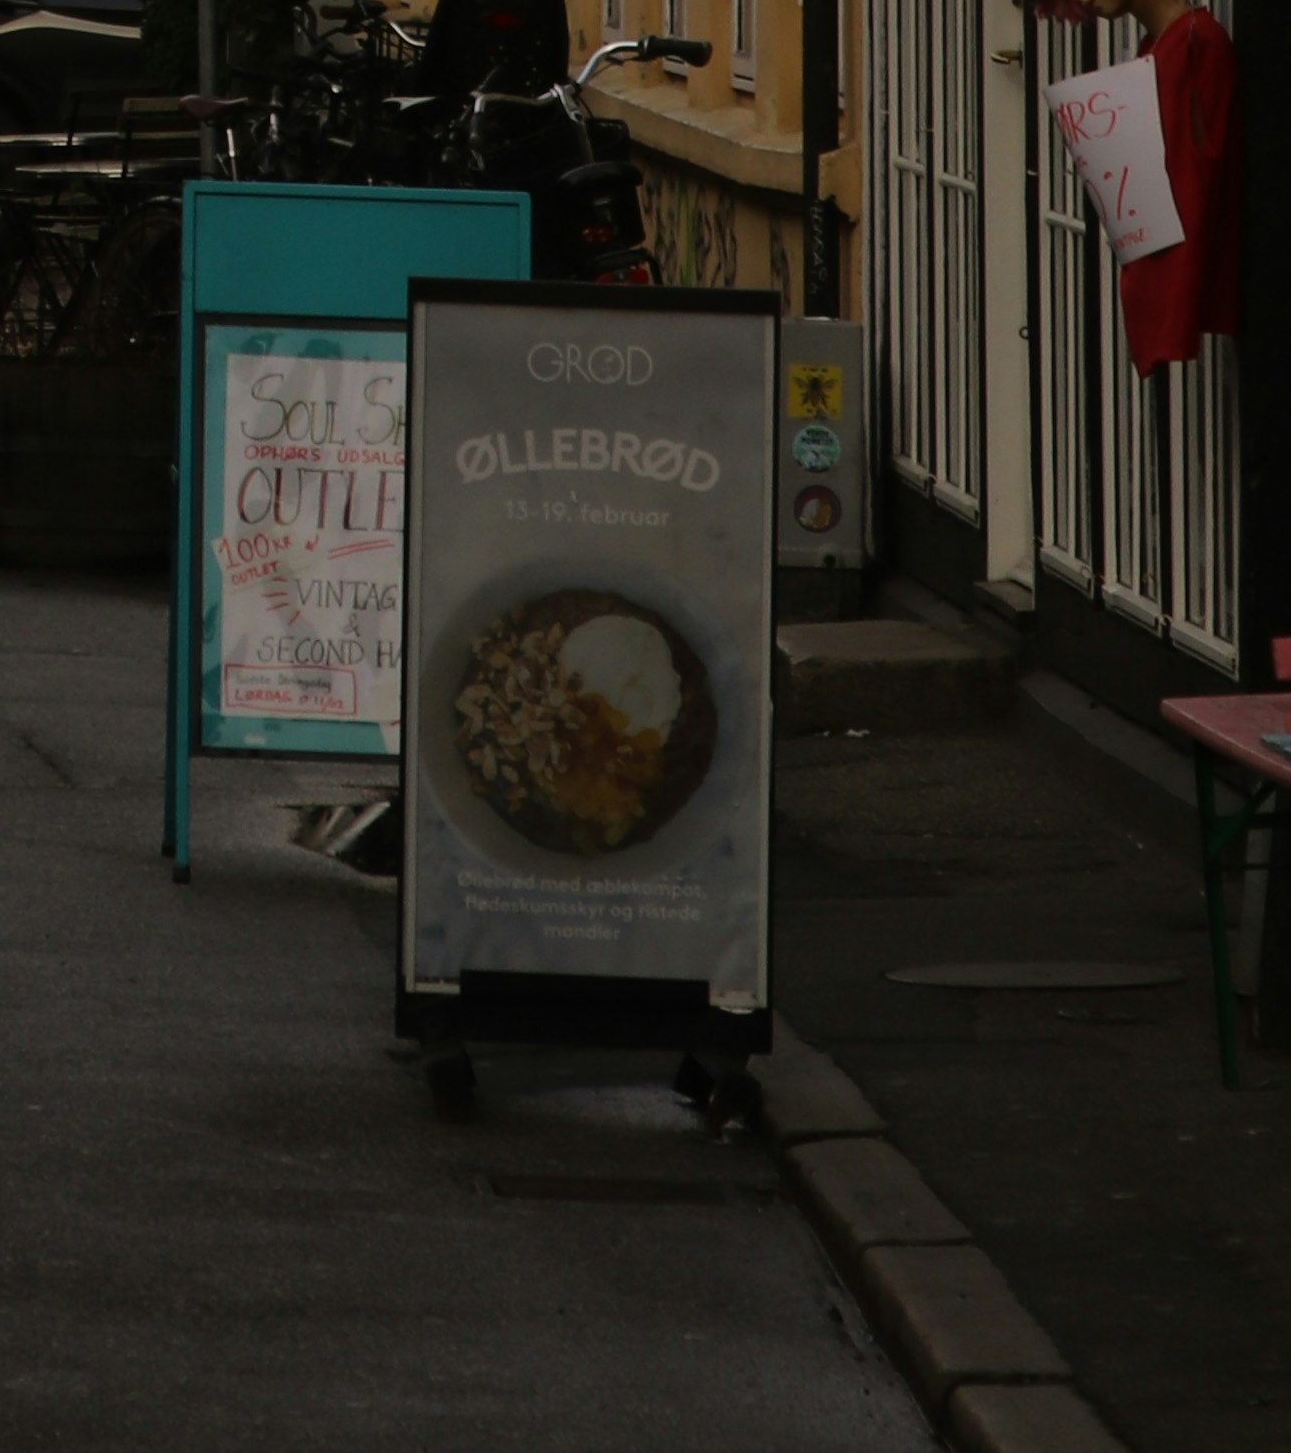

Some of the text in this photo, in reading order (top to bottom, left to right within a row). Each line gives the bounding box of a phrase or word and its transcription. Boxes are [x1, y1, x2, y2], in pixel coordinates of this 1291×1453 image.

[455, 428, 721, 493] ØLLEBRØD
[237, 467, 405, 531] OUTLE
[580, 504, 671, 526] februar
[294, 578, 397, 611] VINTAG
[257, 636, 364, 666] SECOND
[540, 878, 581, 892] med
[611, 906, 633, 923] og
[544, 924, 621, 940] mandler
